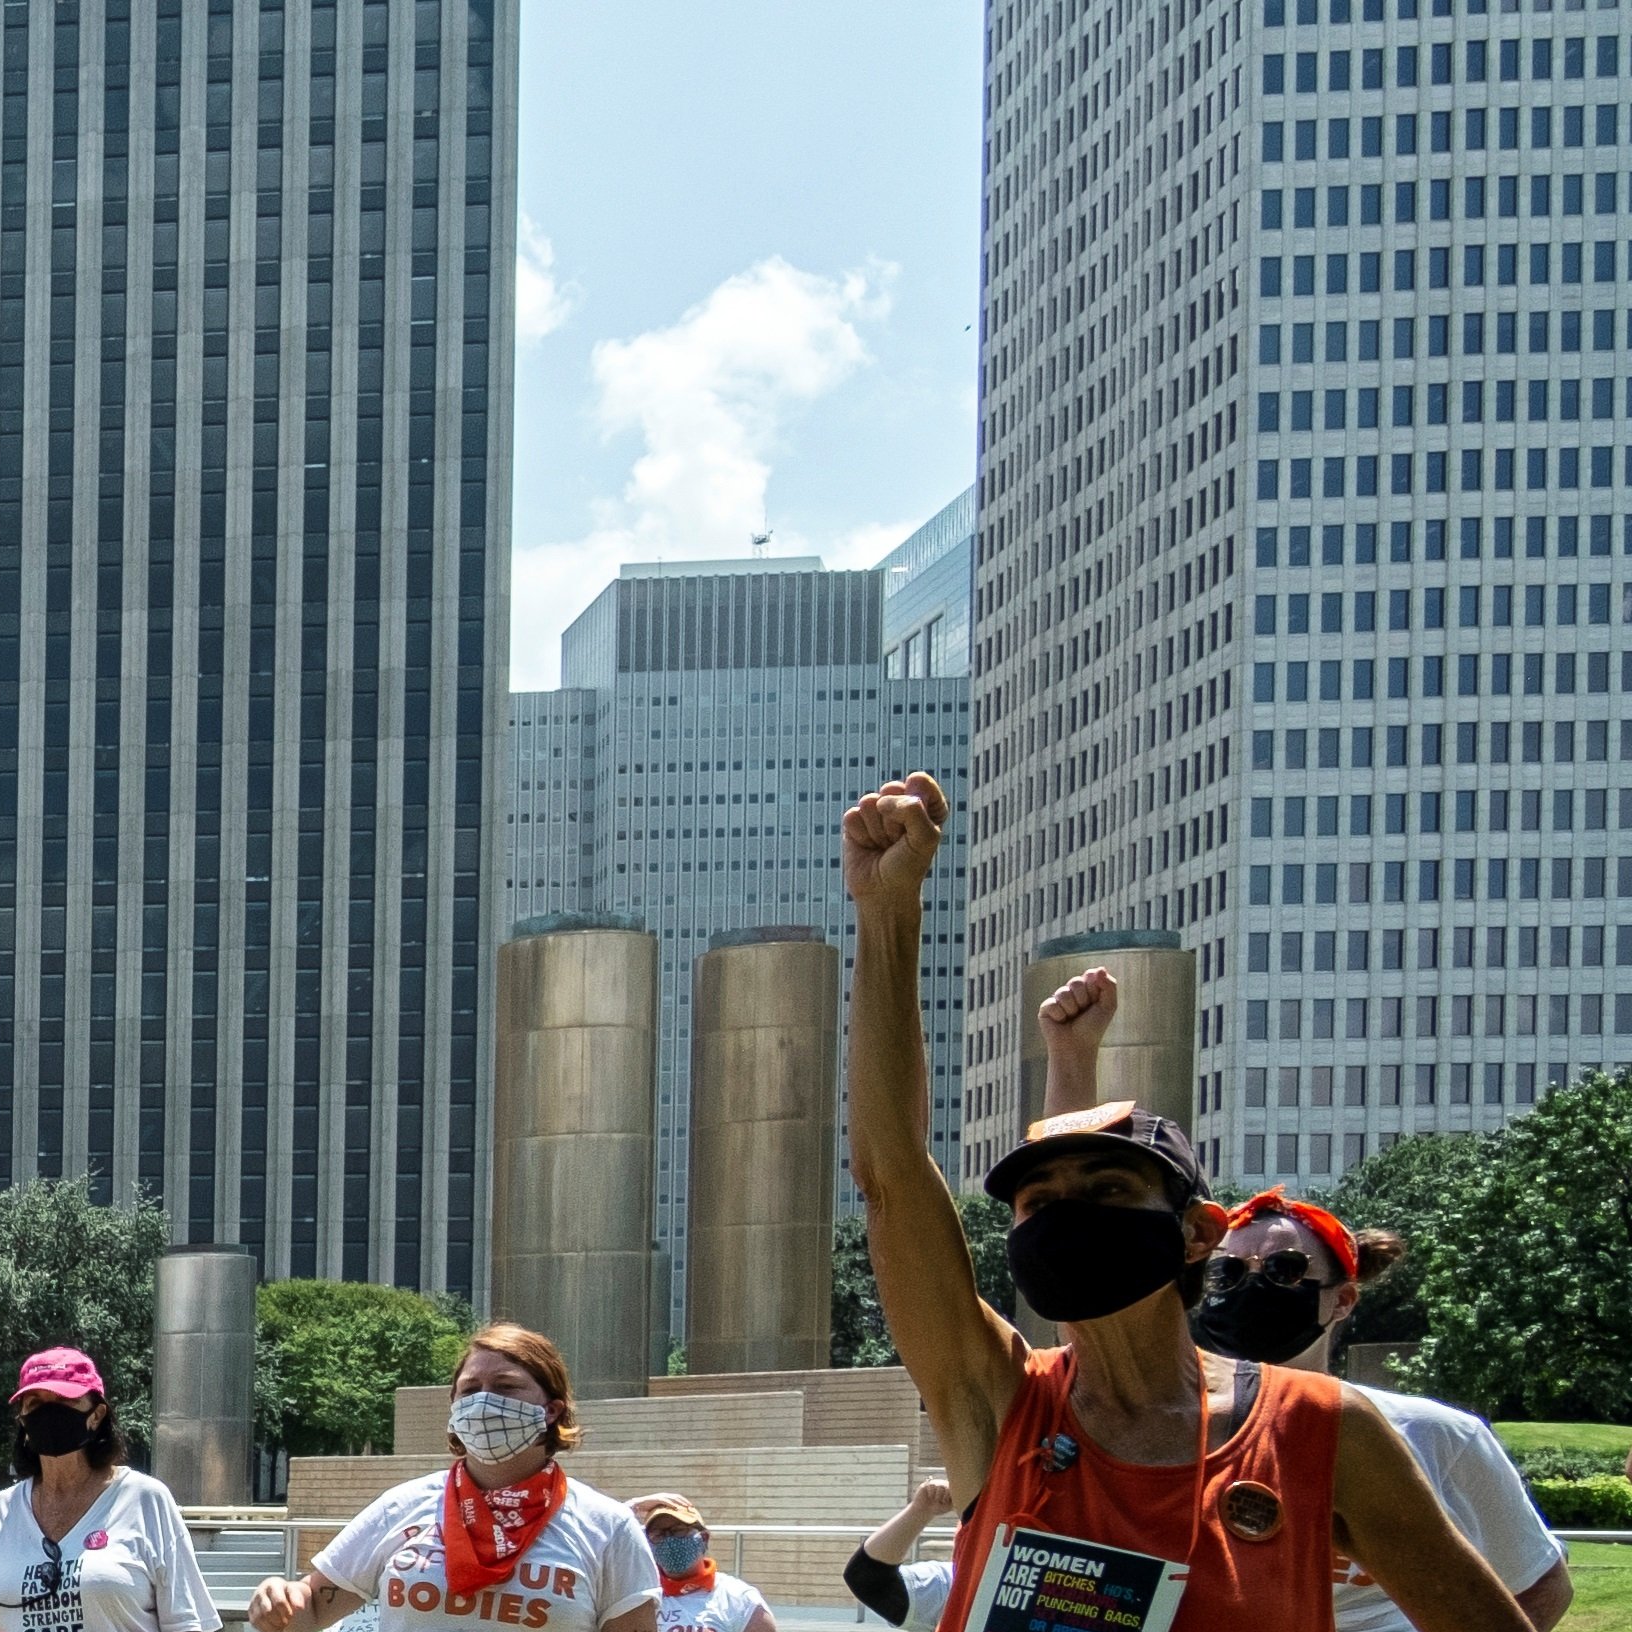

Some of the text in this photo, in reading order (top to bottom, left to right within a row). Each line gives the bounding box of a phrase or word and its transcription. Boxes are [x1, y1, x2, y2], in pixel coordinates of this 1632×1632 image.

[501, 1489, 530, 1499] OUR
[463, 1497, 476, 1525] BANS
[24, 1559, 84, 1581] HELTH
[1012, 1545, 1106, 1578] WOMEN
[21, 1575, 81, 1596] PASION
[498, 1562, 577, 1600] UR
[1003, 1563, 1041, 1589] ARE
[1043, 1570, 1097, 1595] BITCHES,
[387, 1577, 552, 1629] BODIES
[996, 1585, 1035, 1612] NOT
[1036, 1594, 1100, 1619] PUNCHING
[22, 1608, 84, 1628] STRENGTH
[1029, 1618, 1047, 1632] OR
